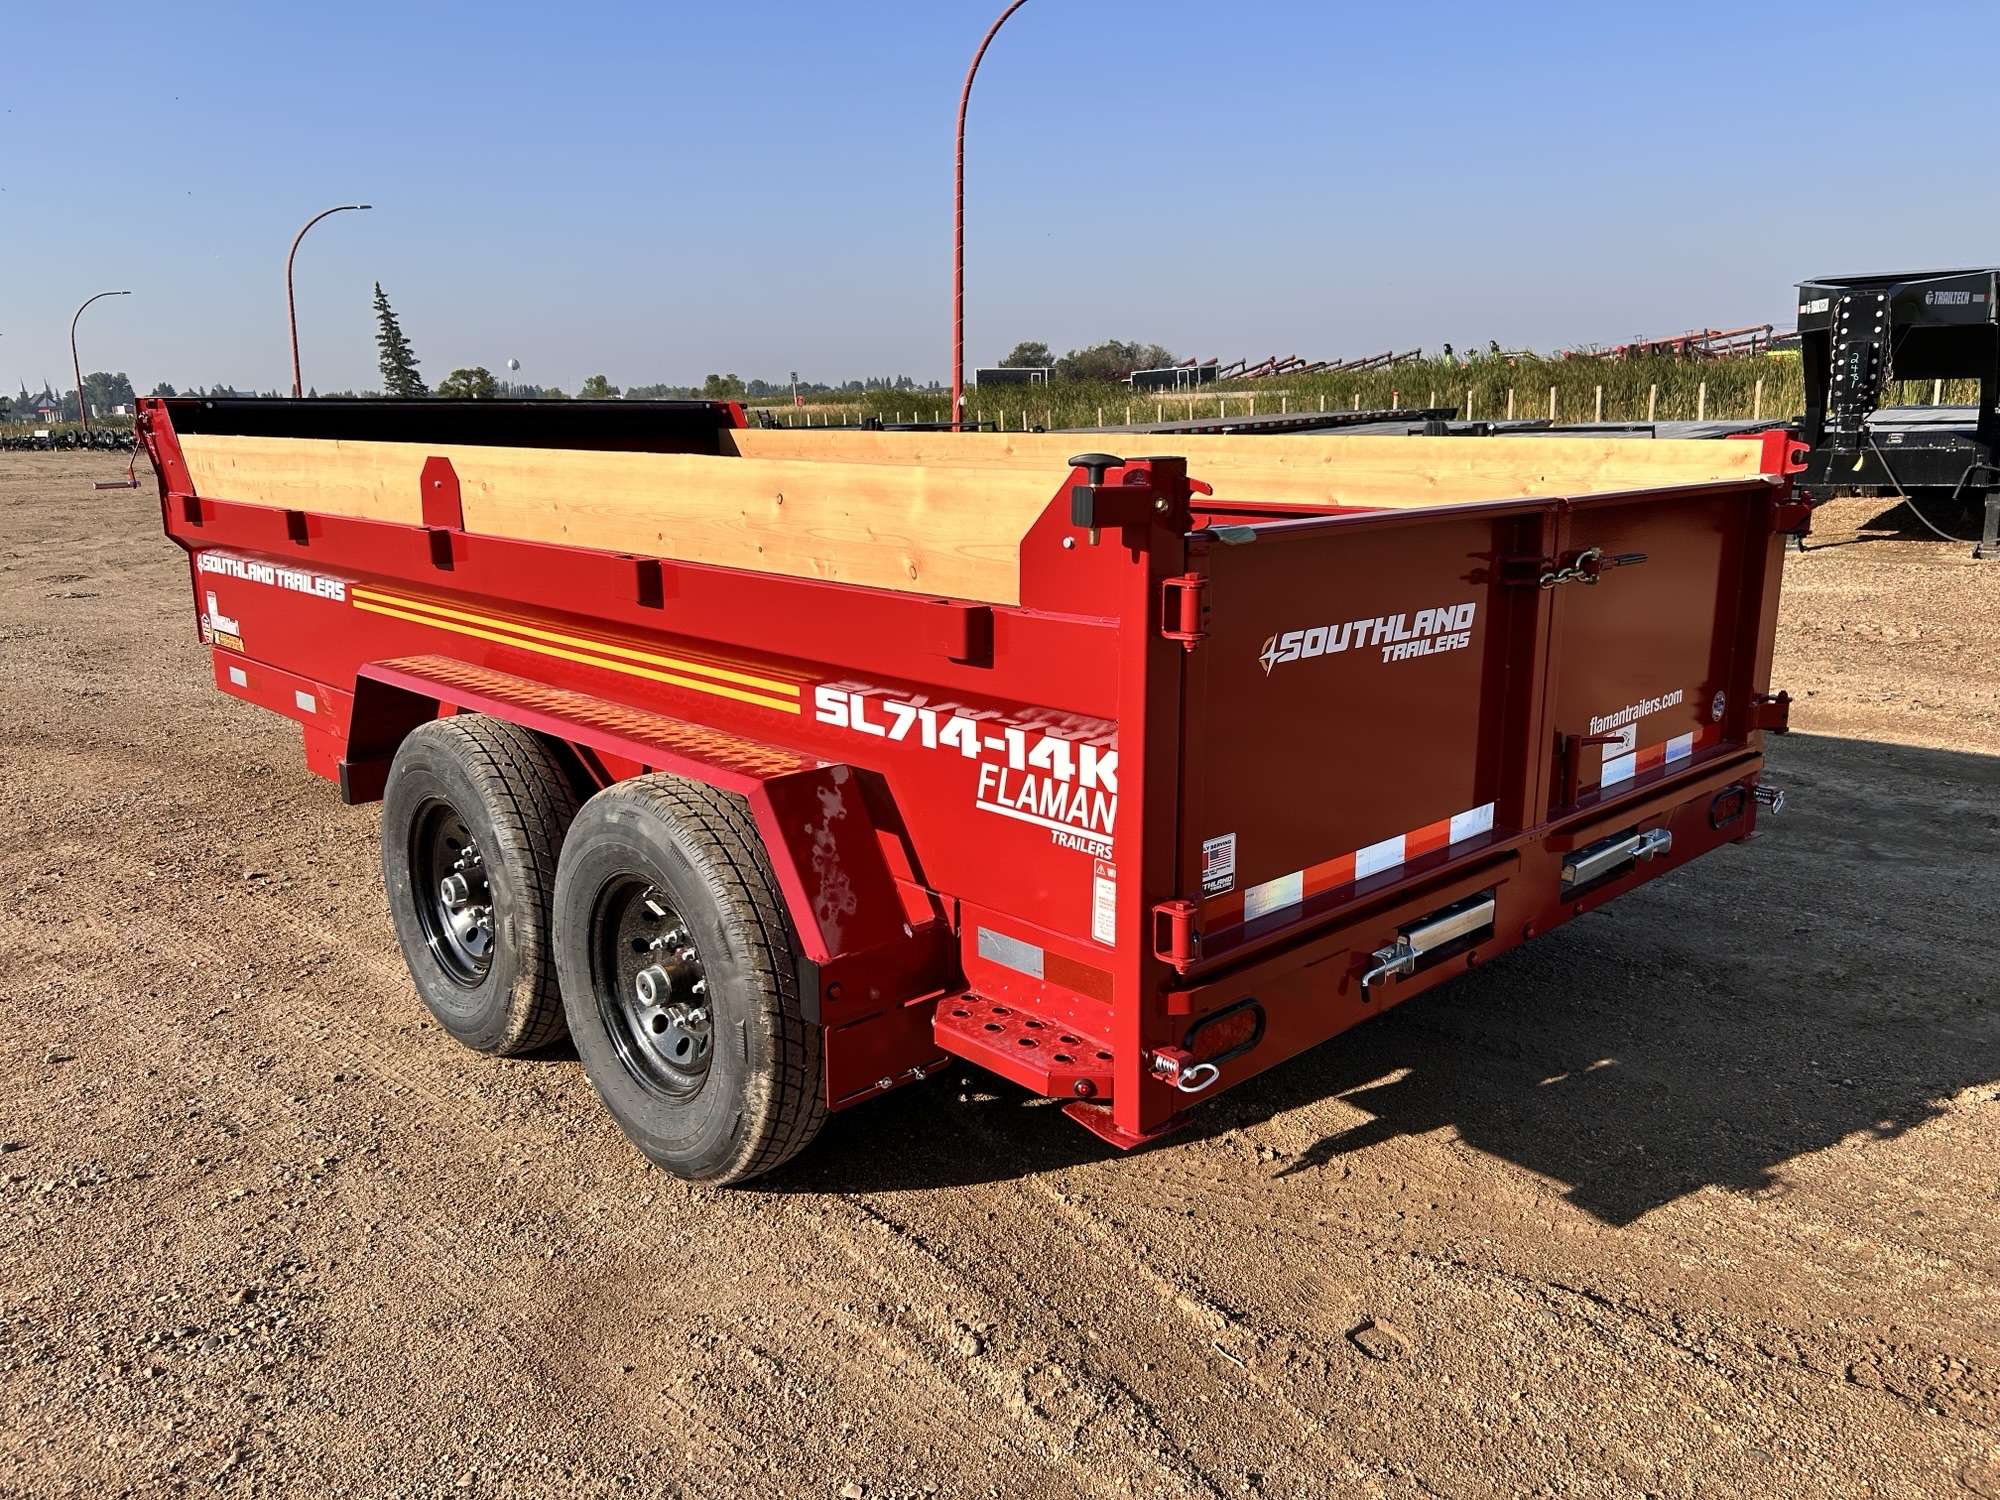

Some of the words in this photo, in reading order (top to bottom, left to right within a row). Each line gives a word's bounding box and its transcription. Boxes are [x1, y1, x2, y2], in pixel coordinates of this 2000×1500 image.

[1934, 291, 1970, 304] TRAILTECH
[202, 554, 275, 585] SOUTHLAND
[275, 568, 346, 602] TRAILERS
[1277, 602, 1476, 663] SOUTHLAND
[1382, 631, 1471, 663] TRAILERS
[1589, 688, 1683, 736] flamantrailers.com
[815, 686, 1118, 794] SL714-14K
[977, 762, 1117, 833] FLAMAN
[1051, 829, 1113, 860] TRAILERS
